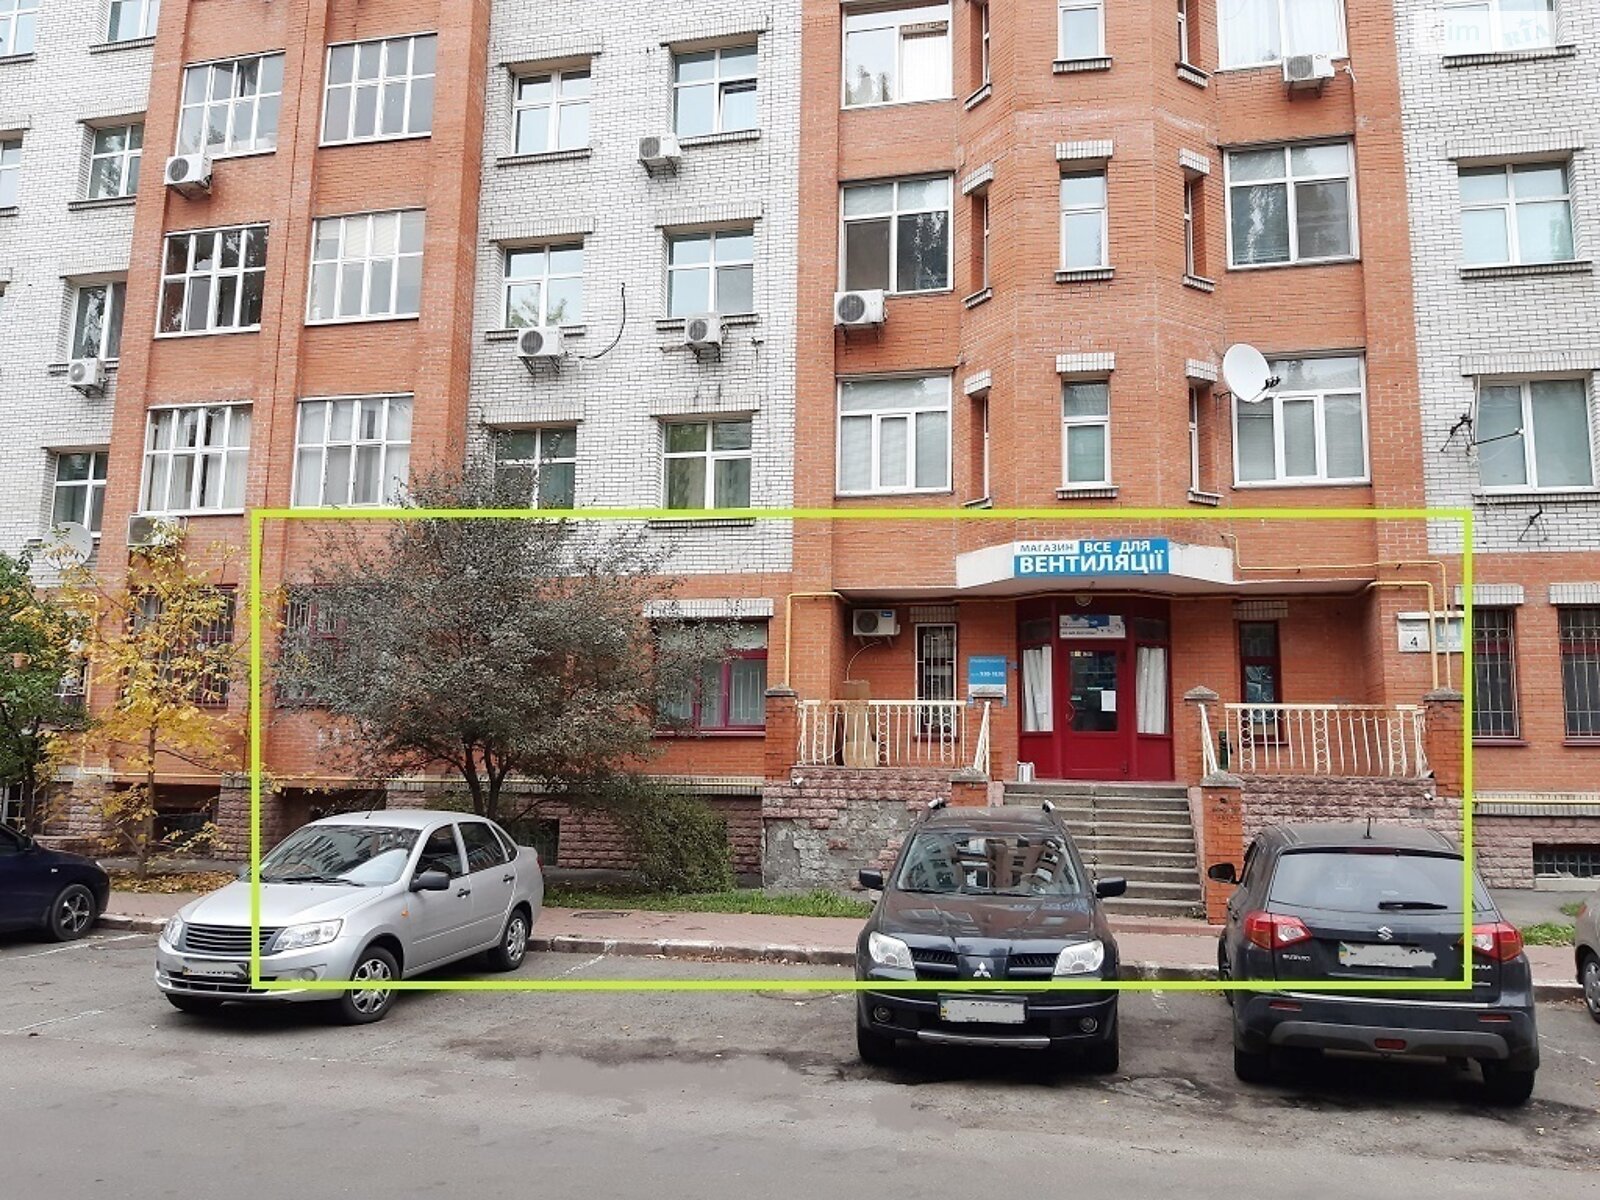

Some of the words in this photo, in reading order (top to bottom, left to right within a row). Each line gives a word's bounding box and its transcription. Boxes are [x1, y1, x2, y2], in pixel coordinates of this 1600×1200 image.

[1019, 543, 1074, 553] МАГАЗИН
[1084, 541, 1112, 554] ВСЕ
[1118, 540, 1151, 554] ДЛЯ
[1019, 550, 1165, 574] ВЕНТИЛЯЦІЇ
